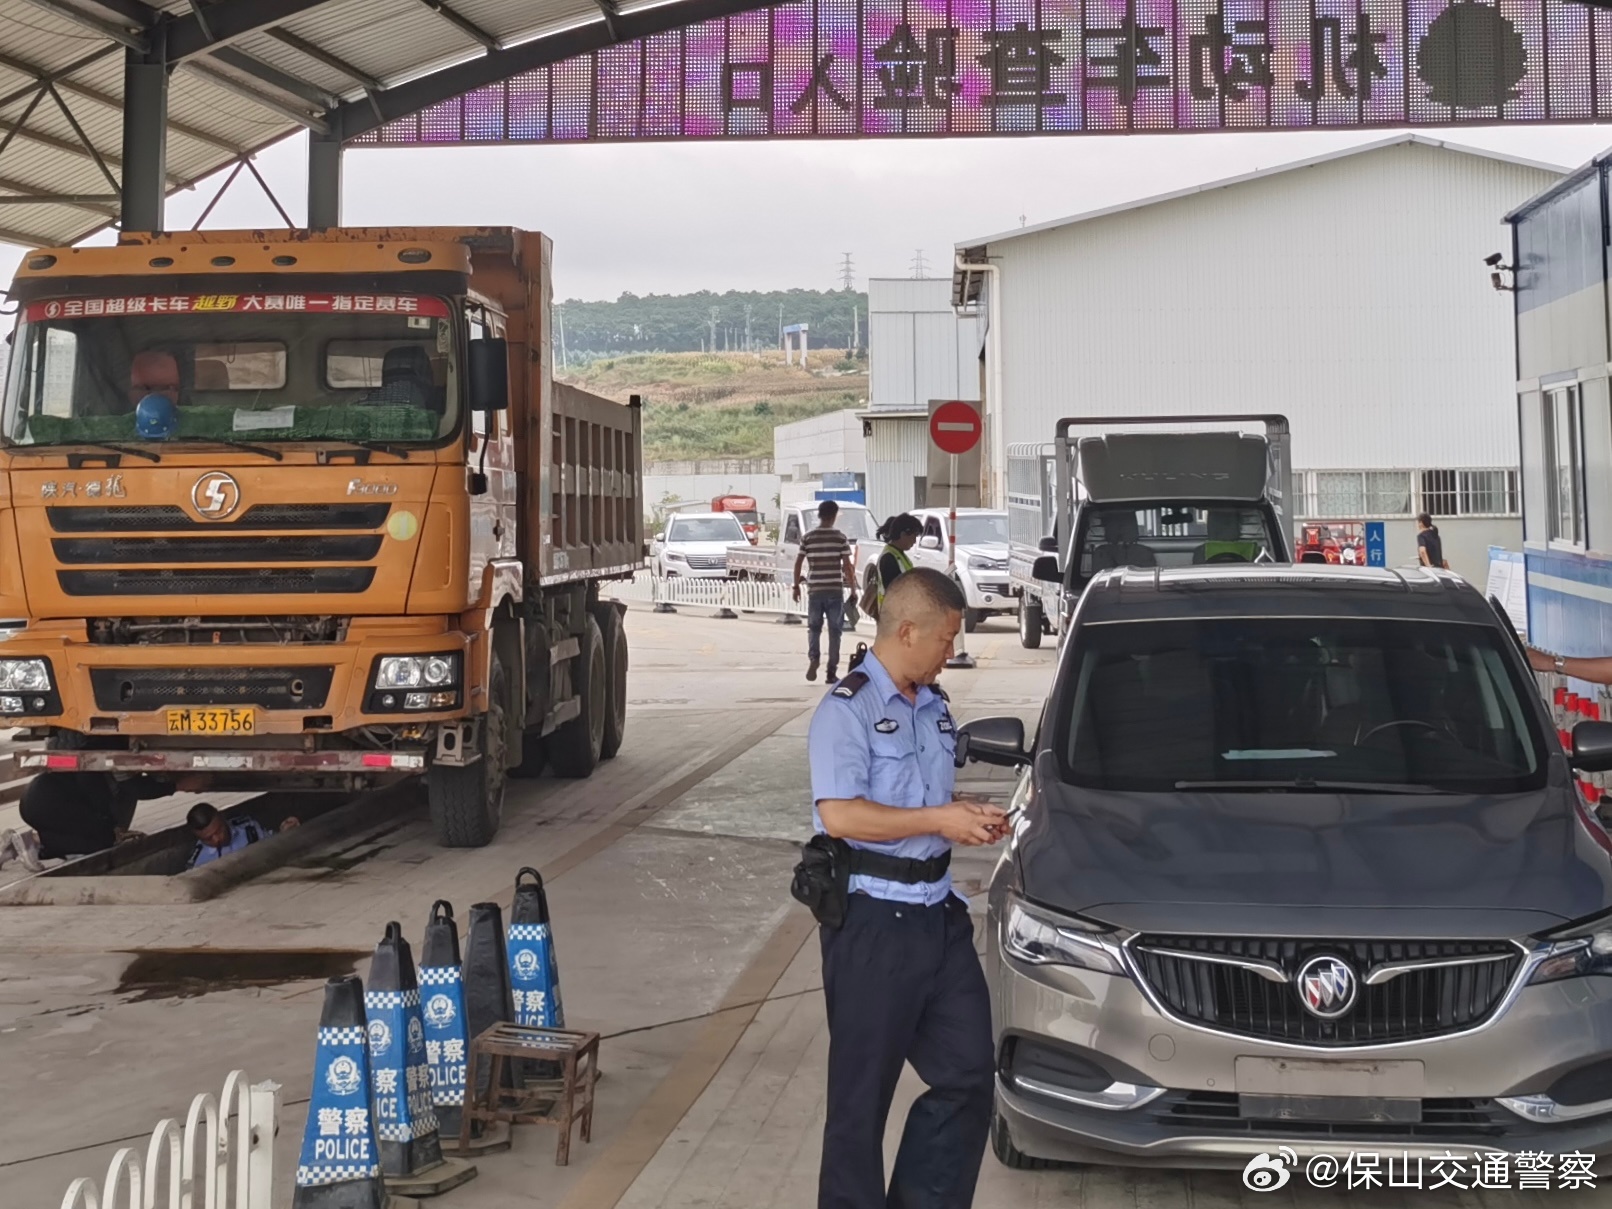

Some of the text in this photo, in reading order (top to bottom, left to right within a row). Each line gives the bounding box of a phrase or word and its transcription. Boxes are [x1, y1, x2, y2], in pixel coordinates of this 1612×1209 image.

[1369, 529, 1383, 562] 人行
[429, 1065, 467, 1087] OLICE
[317, 1106, 369, 1136] 警察
[315, 1138, 370, 1160] POLICE
